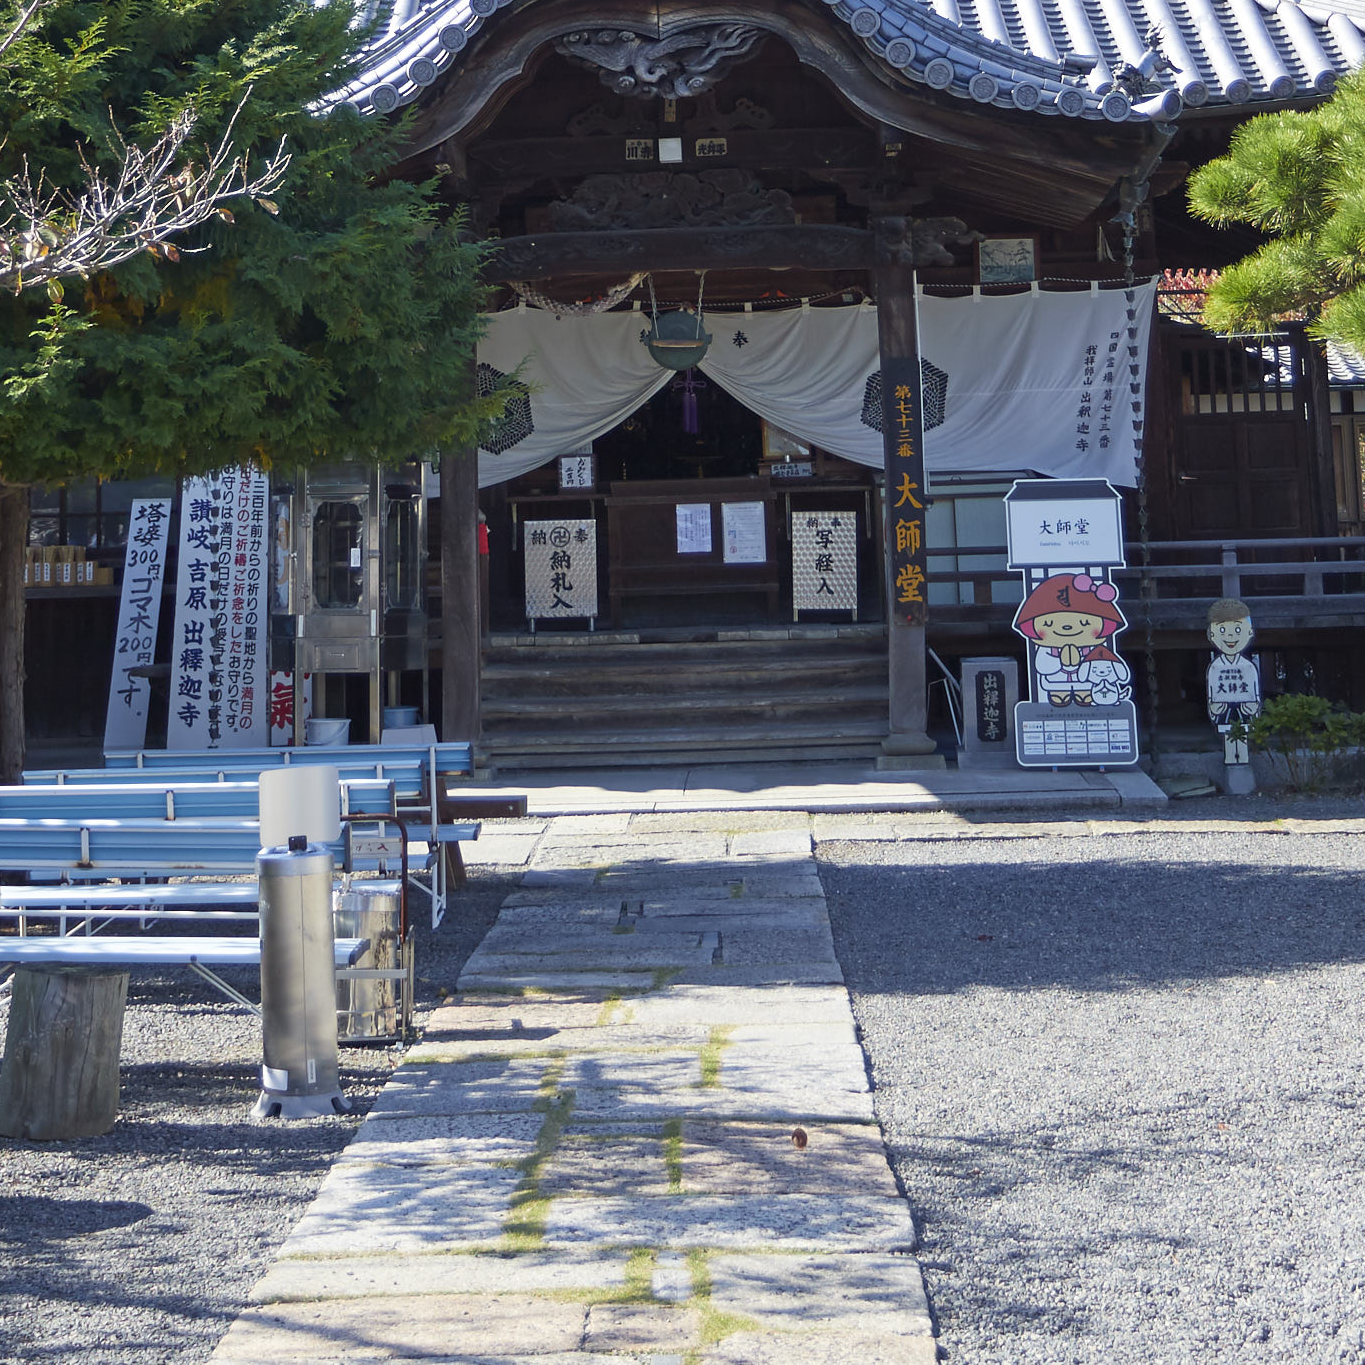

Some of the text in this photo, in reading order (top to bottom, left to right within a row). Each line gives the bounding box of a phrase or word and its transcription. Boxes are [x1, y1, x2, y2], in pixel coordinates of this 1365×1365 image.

[732, 330, 749, 348] 奉
[894, 385, 925, 603] 第七十三番 大師堂
[1038, 517, 1091, 535] 大師堂
[184, 557, 210, 612] 吉原
[549, 550, 574, 611] 納札入
[814, 529, 836, 597] 写経入
